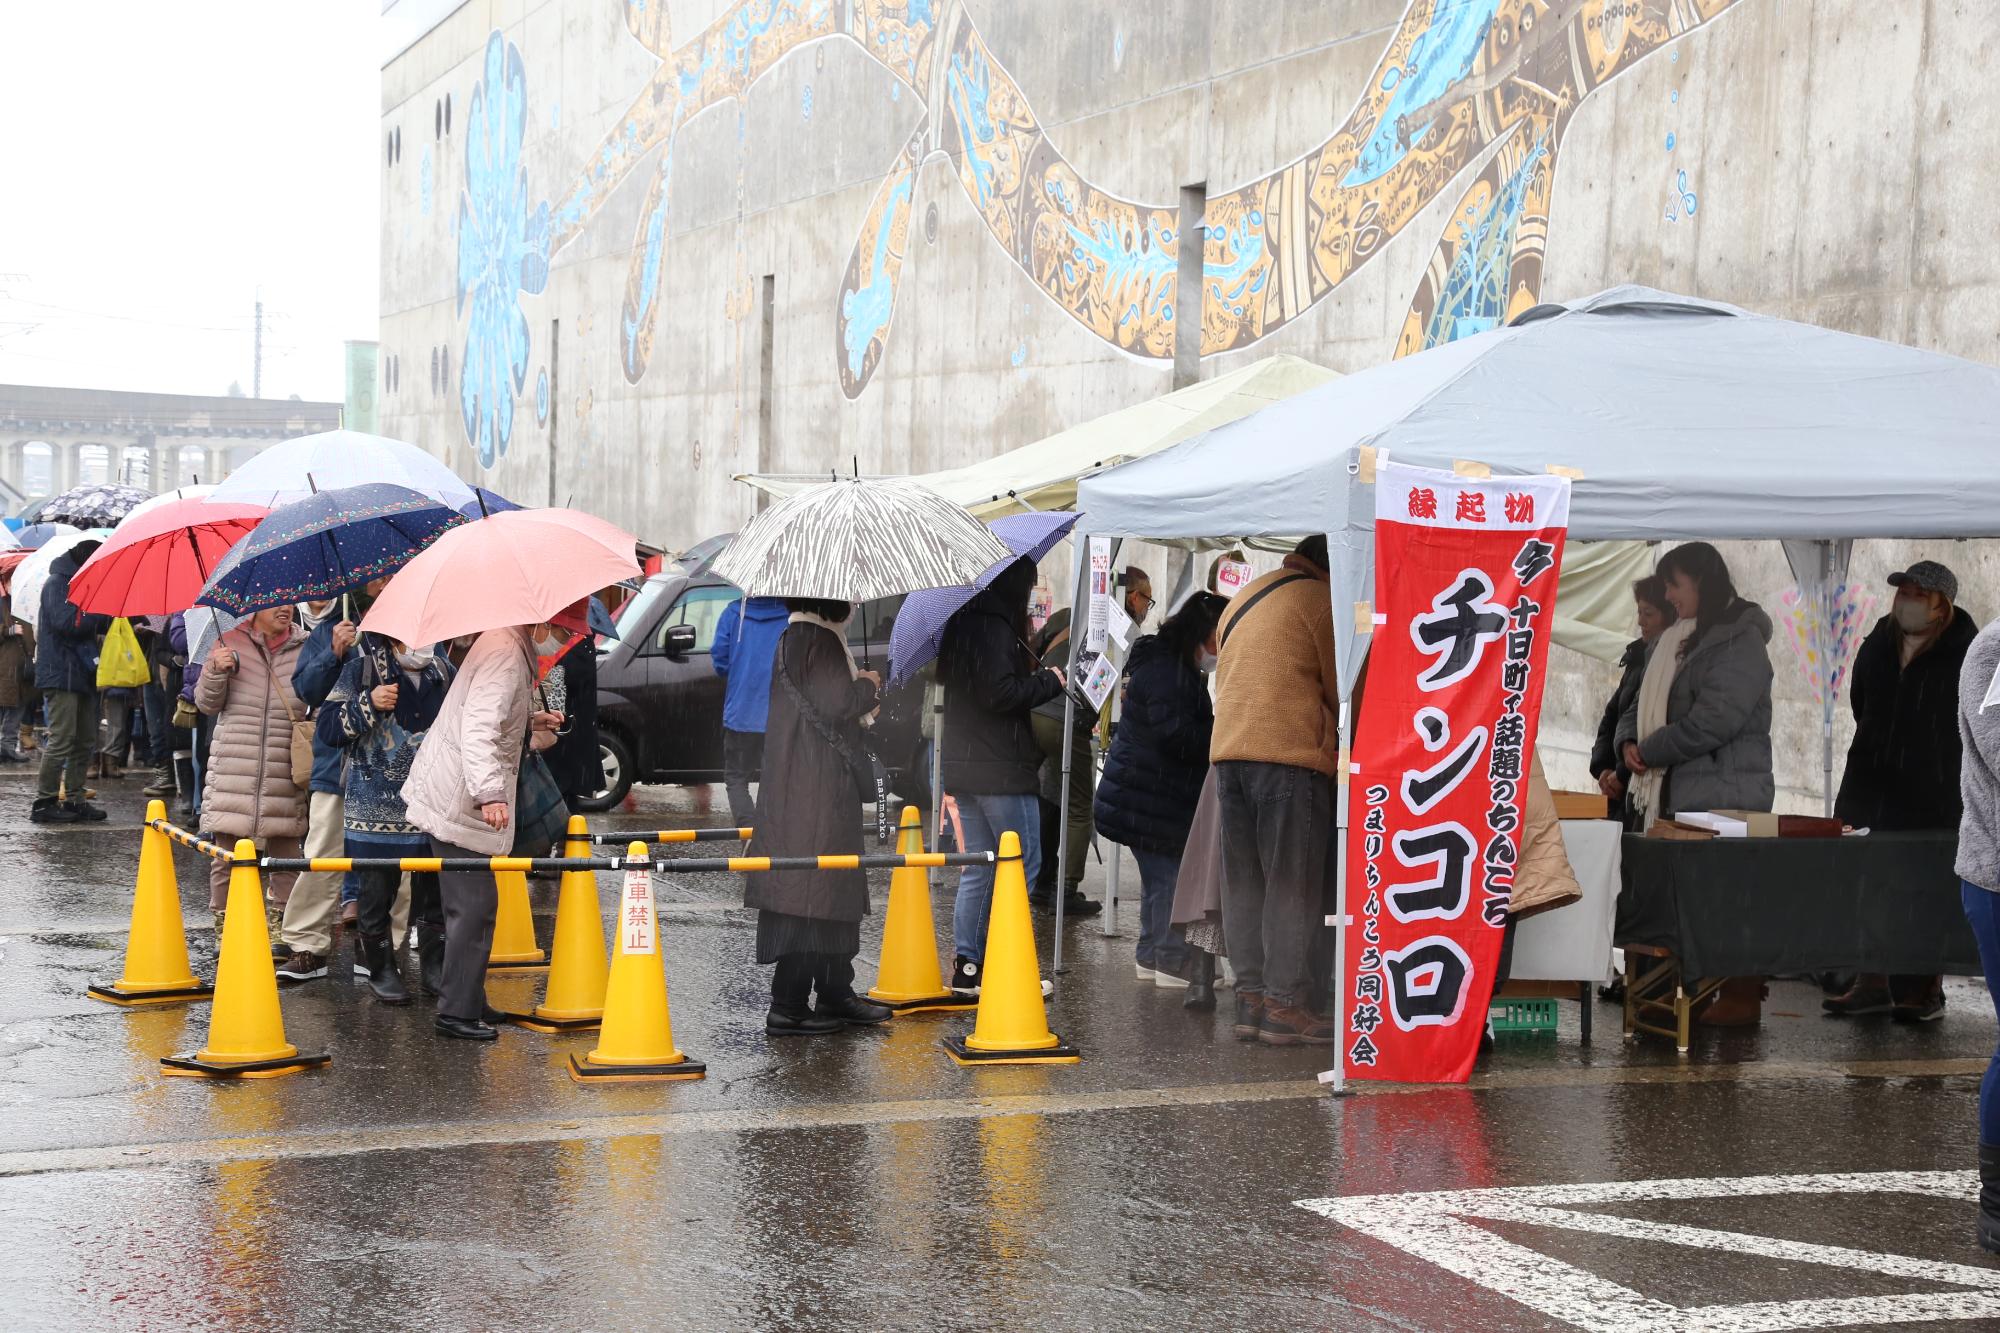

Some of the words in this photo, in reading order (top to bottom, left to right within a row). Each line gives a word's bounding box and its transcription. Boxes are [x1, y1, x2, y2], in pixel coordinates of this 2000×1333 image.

[1408, 486, 1535, 524] 縁起物
[876, 778, 886, 839] marimekko
[1384, 570, 1508, 1029] チンコロ
[1352, 784, 1388, 1065] つまりちんころ同好会
